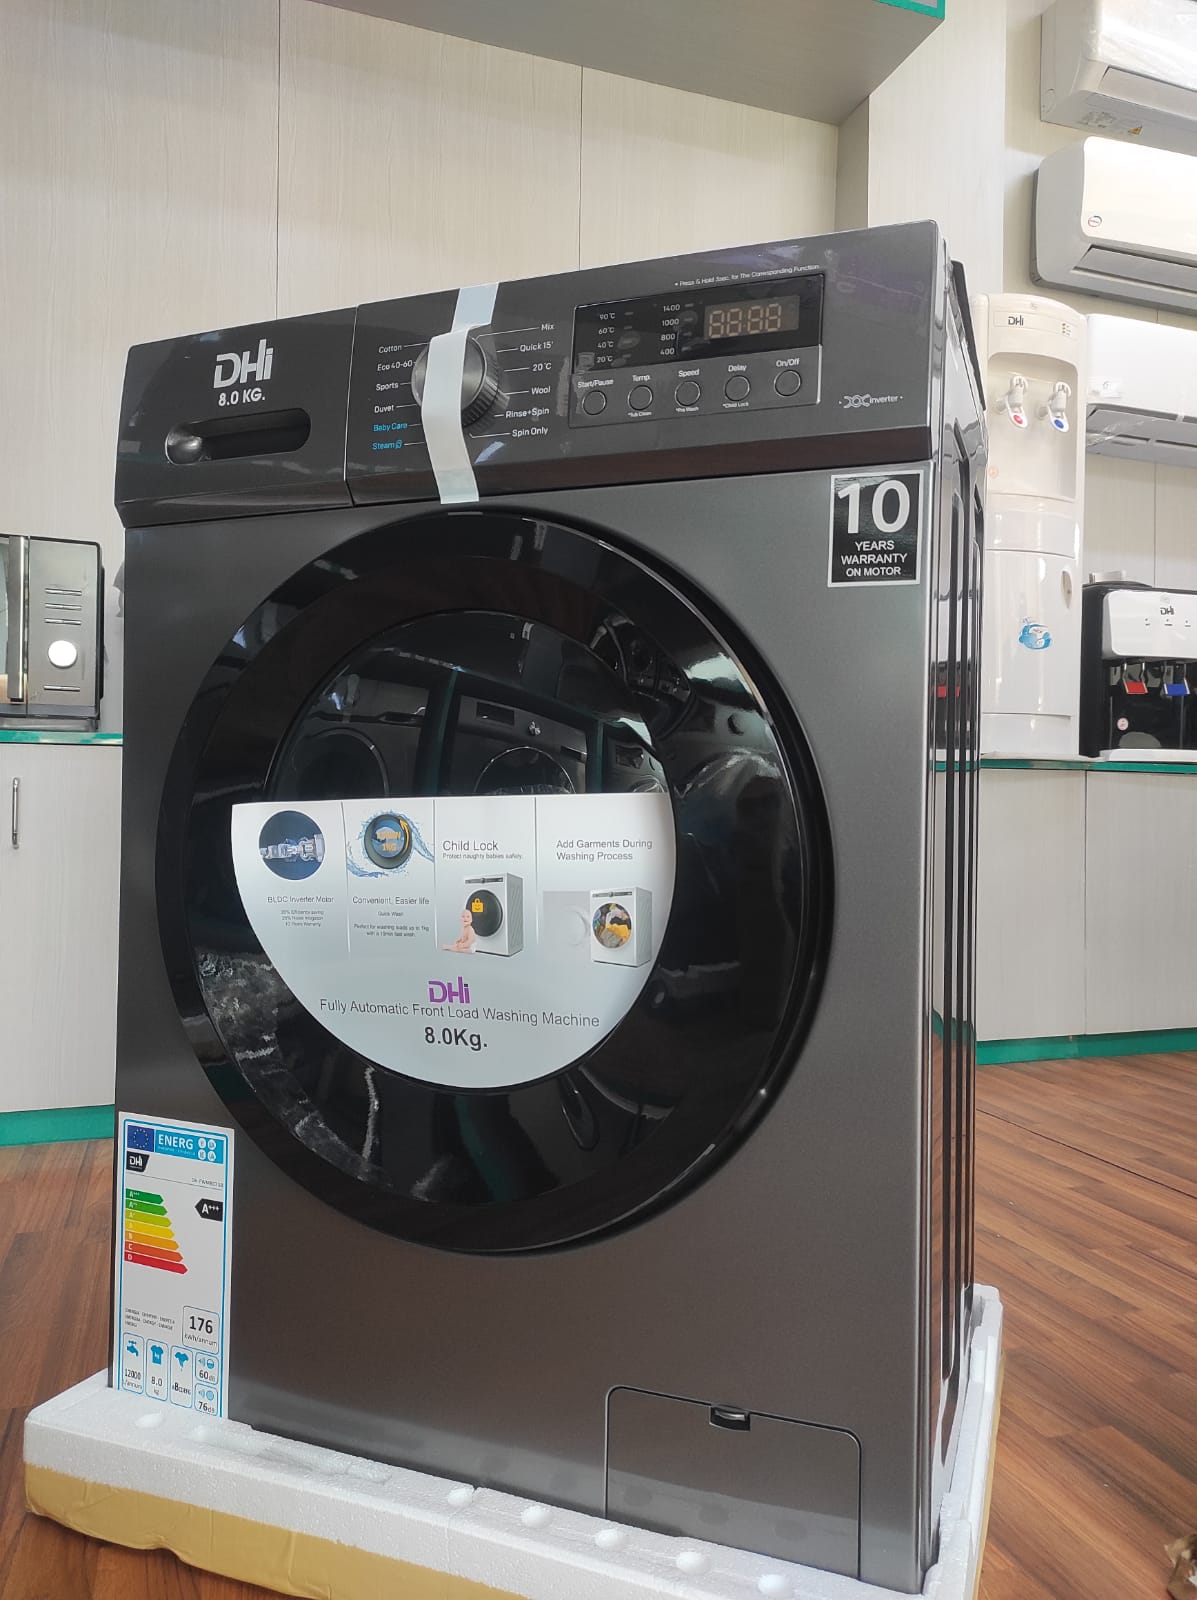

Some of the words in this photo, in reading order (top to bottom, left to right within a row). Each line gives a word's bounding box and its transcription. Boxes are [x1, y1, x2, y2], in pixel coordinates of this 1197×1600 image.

[663, 304, 680, 312] 1400
[662, 318, 680, 326] 1000
[660, 333, 675, 341] 800
[379, 344, 402, 353] Cotton
[520, 343, 542, 352] Quick
[660, 347, 675, 355] 400
[377, 363, 390, 371] Eco
[391, 360, 412, 369] 40-60
[728, 364, 747, 372] Delay
[776, 358, 799, 368] On/Off
[376, 382, 398, 391] Sports
[578, 379, 614, 388] Start/Pause
[532, 386, 550, 394] Wool
[218, 391, 239, 406] 8.0
[242, 388, 266, 403] KG.
[375, 405, 394, 413] Duvet
[506, 408, 550, 419] Rinse+Spin
[373, 423, 390, 432] Baby
[392, 422, 408, 430] Care
[512, 428, 530, 438] Spin
[531, 427, 548, 436] Only
[838, 480, 910, 534] 10
[855, 540, 894, 551] YEARS
[841, 553, 907, 565] WARRANTY
[846, 568, 861, 576] ON
[864, 567, 901, 576] MOTOR
[443, 840, 469, 851] Child
[474, 840, 498, 851] Lock
[556, 840, 574, 849] Add
[576, 839, 620, 849] Garments
[622, 839, 652, 850] During
[556, 852, 594, 862] Washing
[597, 852, 633, 860] Process
[428, 976, 470, 1004] DHi
[320, 999, 347, 1014] Fully
[350, 1000, 409, 1015] Automatic
[413, 1004, 444, 1017] Front
[448, 1006, 479, 1019] Load
[482, 1008, 538, 1026] Washing
[542, 1012, 600, 1027] Machine
[424, 1027, 488, 1051] 8.0Kg.
[158, 1134, 194, 1150] ENERG
[202, 1203, 219, 1214] A+++
[190, 1316, 213, 1334] 176
[152, 1376, 162, 1386] 8.0
